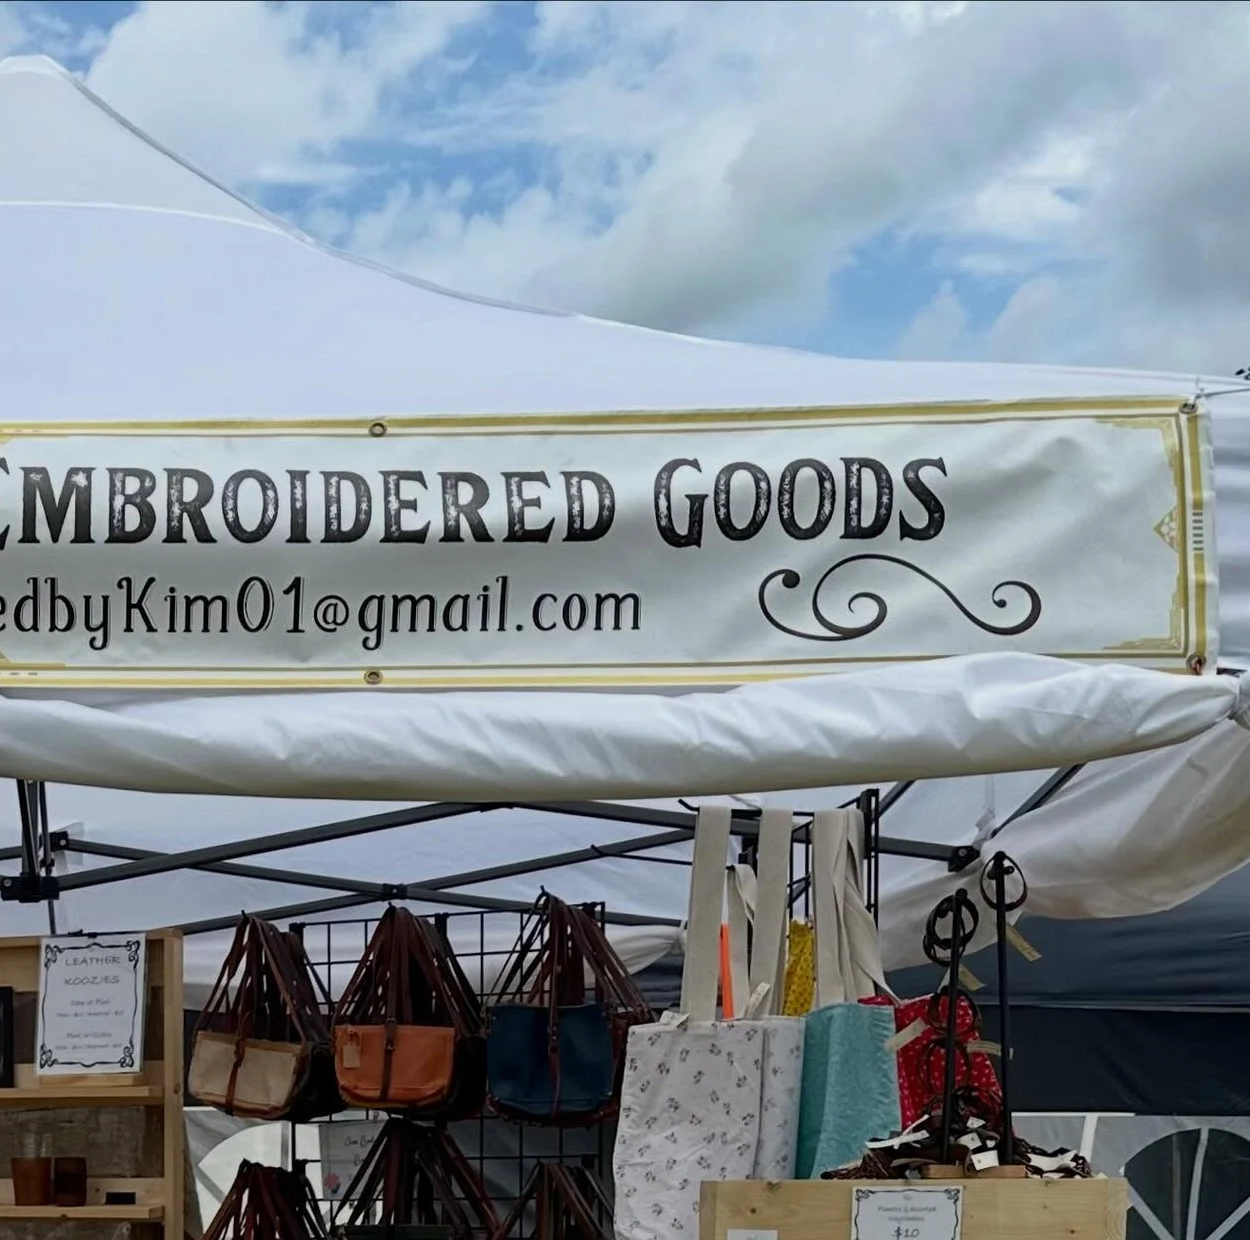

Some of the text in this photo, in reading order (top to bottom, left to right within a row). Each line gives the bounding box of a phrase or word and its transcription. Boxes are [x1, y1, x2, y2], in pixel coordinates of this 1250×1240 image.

[654, 457, 949, 550] GOODS
[65, 956, 121, 967] LEATHER
[64, 975, 120, 986] KOOZIES
